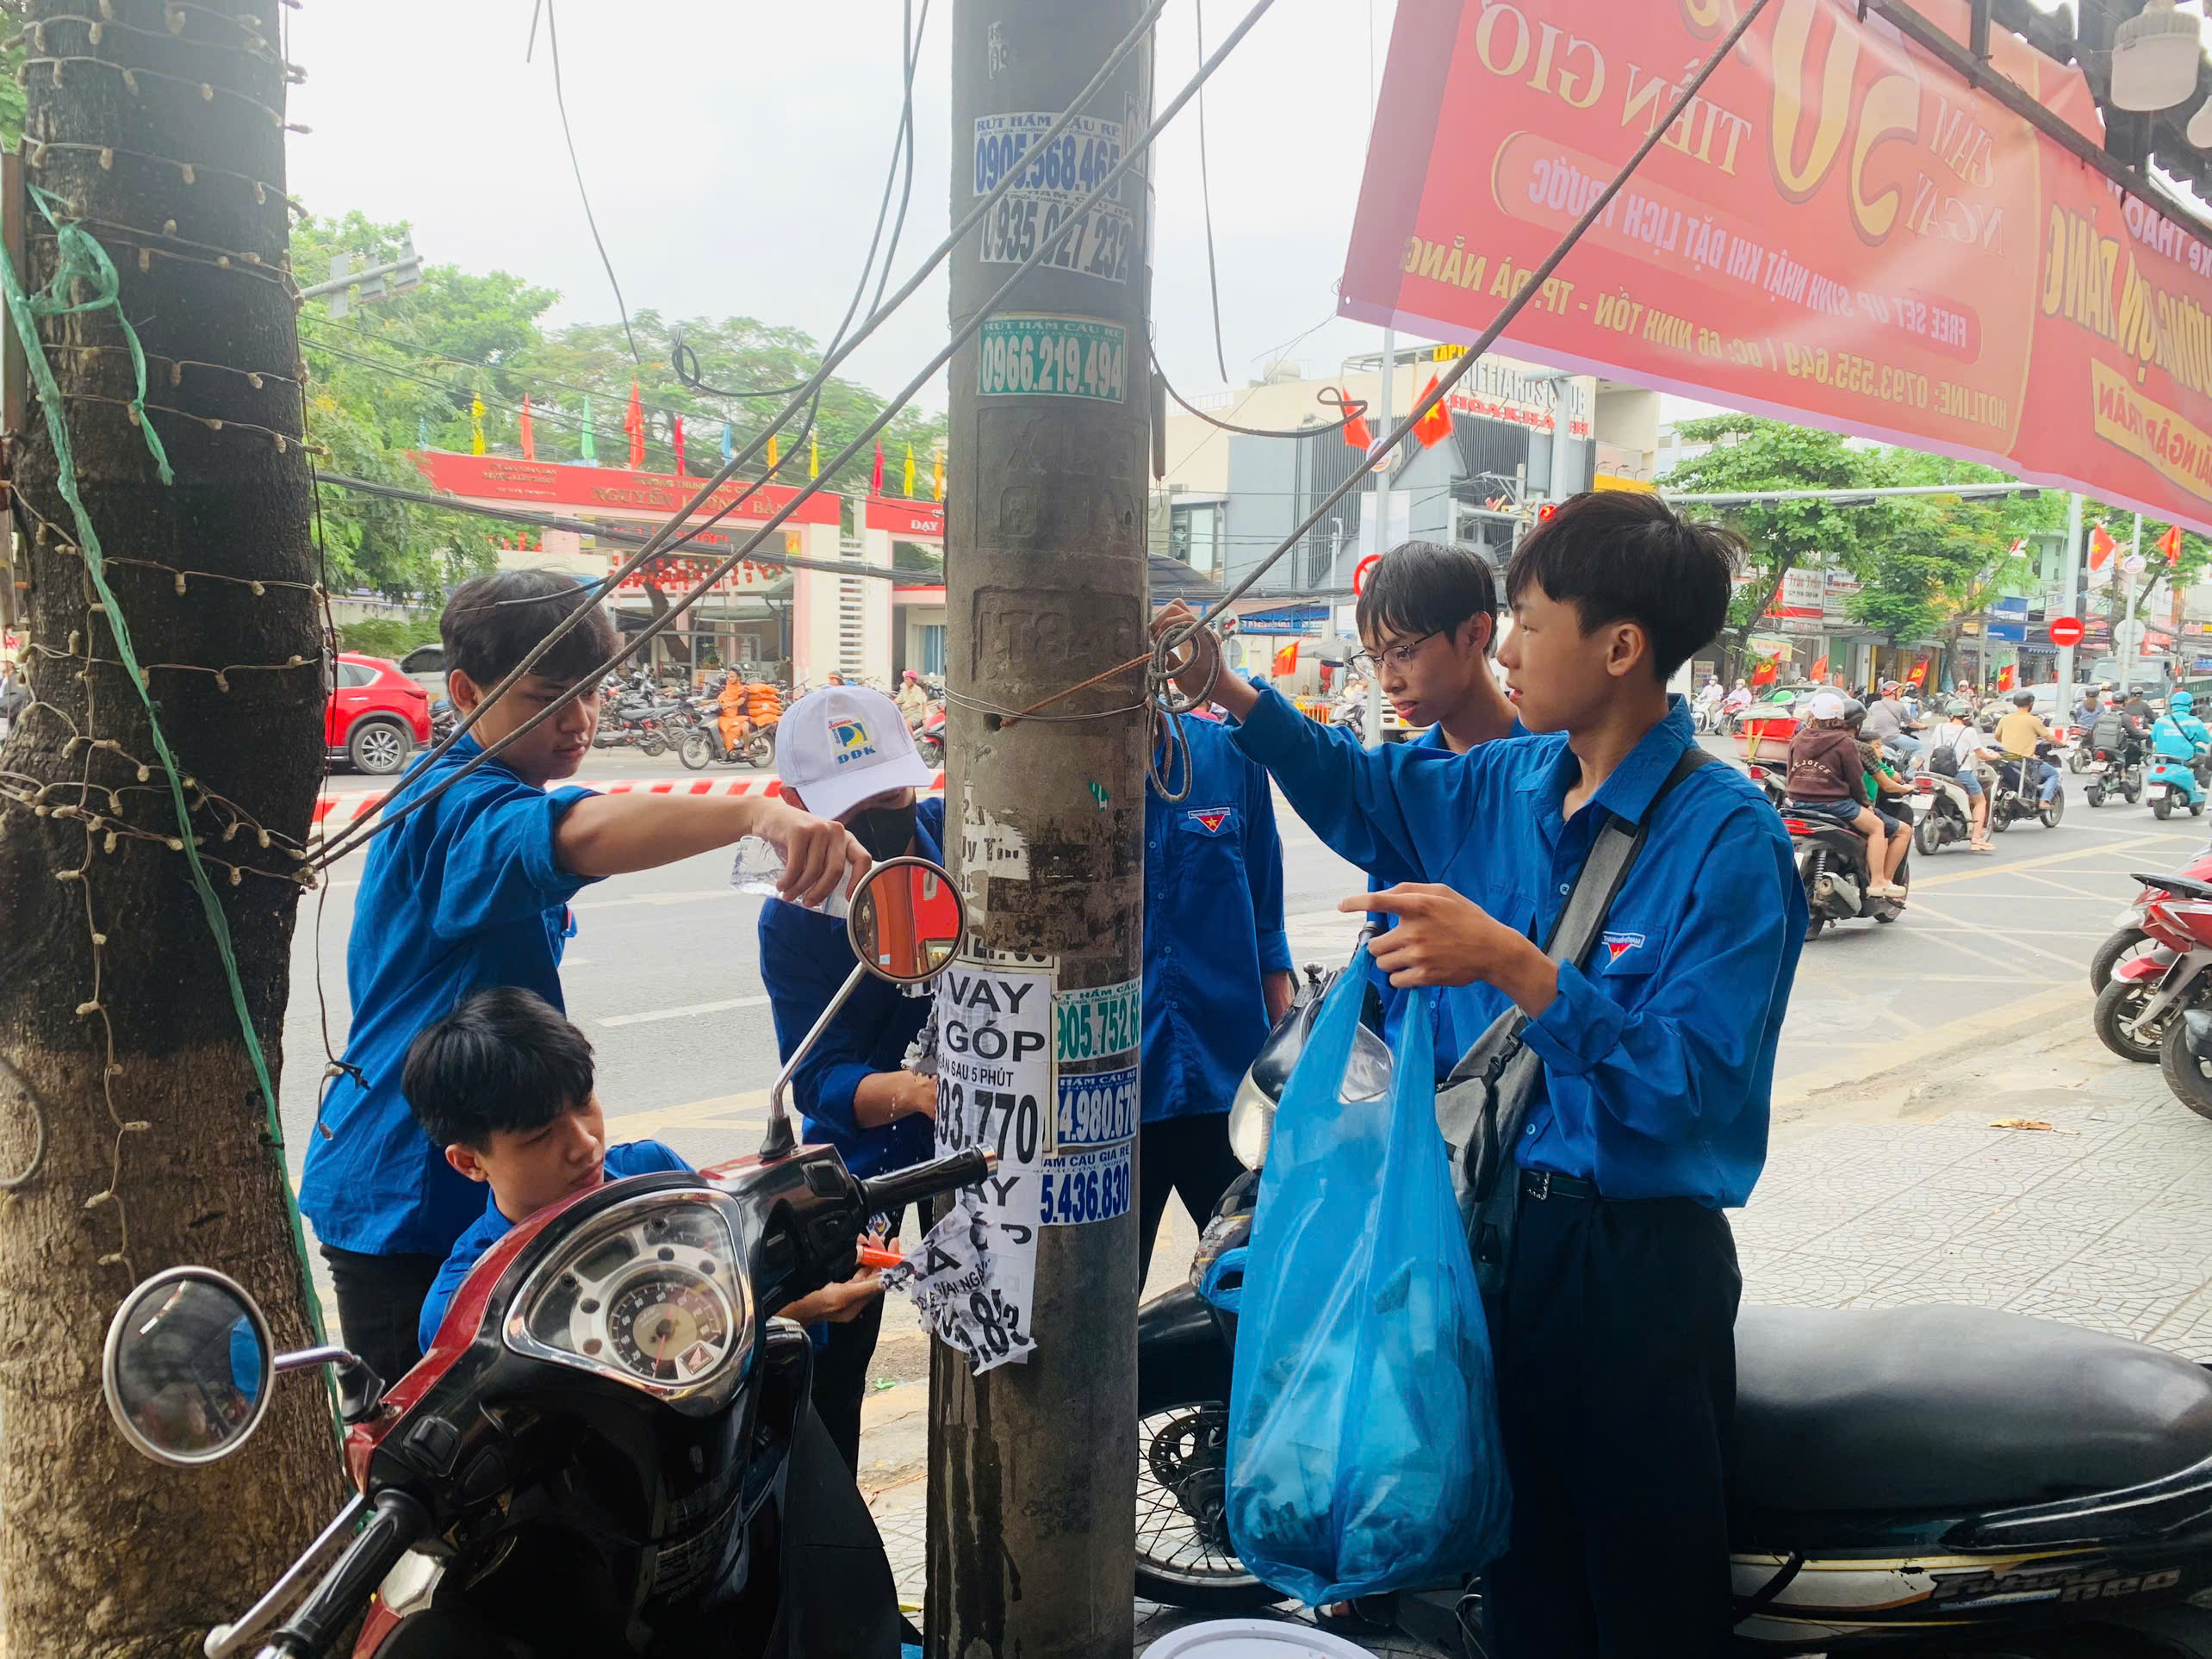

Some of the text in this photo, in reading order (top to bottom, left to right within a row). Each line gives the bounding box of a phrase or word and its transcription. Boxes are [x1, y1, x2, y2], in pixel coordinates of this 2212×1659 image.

[982, 334, 1123, 399] 0966.219.494
[948, 971, 1034, 1014] VAY
[946, 1019, 1046, 1063] GÓP
[951, 1064, 969, 1082] SAU
[972, 1069, 978, 1083] 5
[980, 1066, 1014, 1088] PHÚT
[1059, 1080, 1137, 1142] 4.980.676
[962, 1176, 1021, 1206] AY
[1041, 1161, 1129, 1224] 5.436.830
[631, 1350, 642, 1361] 20
